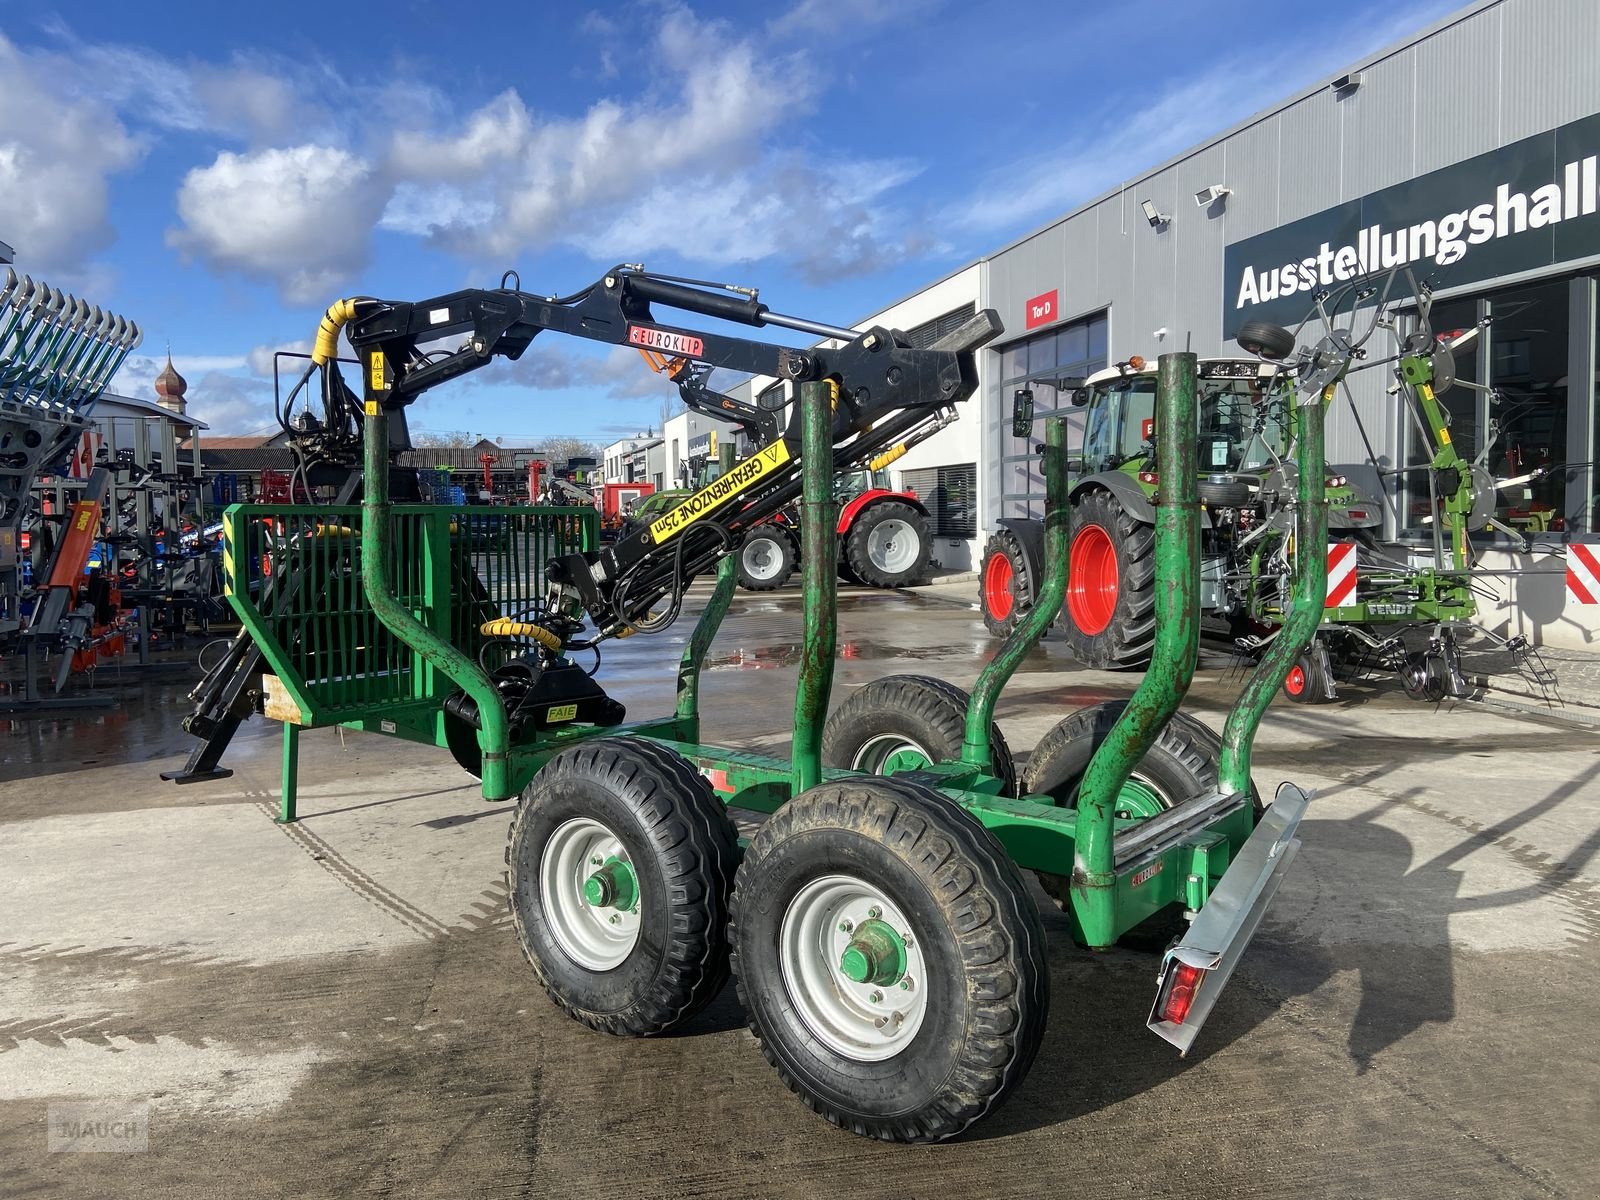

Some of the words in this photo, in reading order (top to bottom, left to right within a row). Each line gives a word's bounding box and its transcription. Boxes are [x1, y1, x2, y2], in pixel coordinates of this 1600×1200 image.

[1236, 155, 1600, 310] Ausstellungshall
[1032, 306, 1044, 319] Tor
[1044, 301, 1051, 315] D
[641, 330, 700, 353] EUROKLIP
[680, 458, 763, 522] GEFAHRENZONE
[654, 512, 680, 534] 25m
[1368, 604, 1416, 615] FENDT
[549, 706, 576, 718] FAIE
